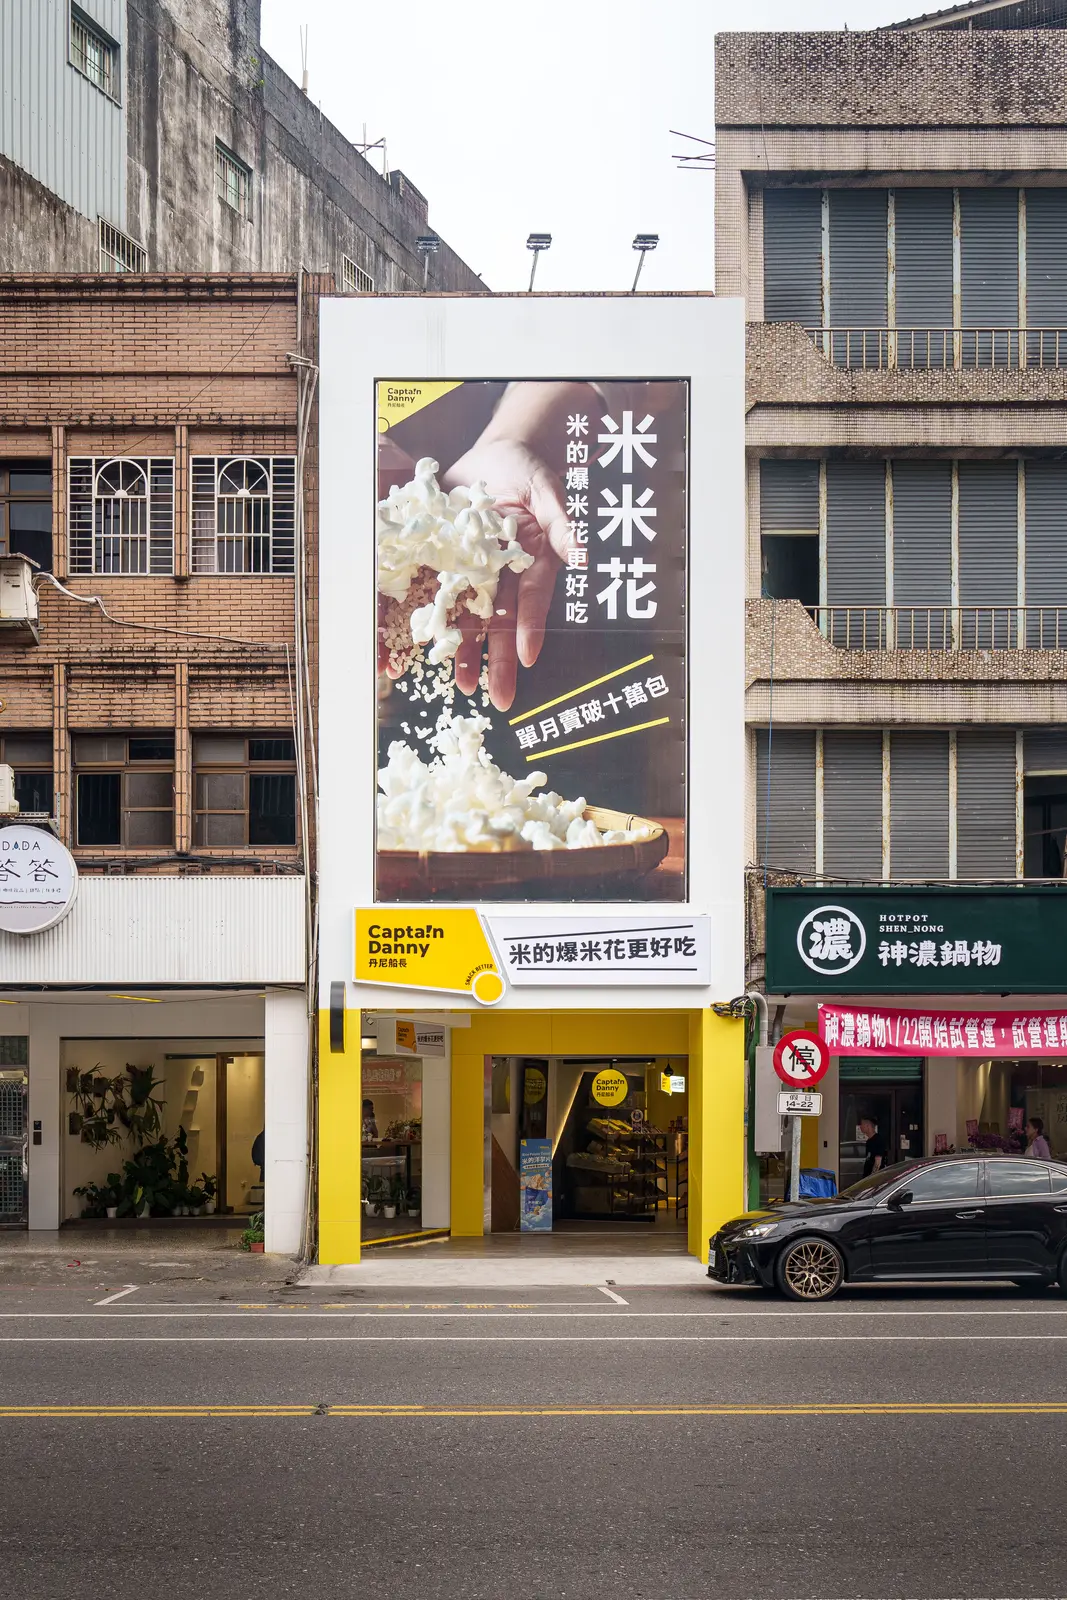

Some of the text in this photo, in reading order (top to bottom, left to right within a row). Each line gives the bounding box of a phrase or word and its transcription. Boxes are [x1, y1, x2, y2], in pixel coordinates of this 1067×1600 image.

[388, 395, 416, 403] Danny
[565, 413, 589, 624] 米的爆米花更好吃
[596, 410, 658, 620] 米米花
[515, 674, 670, 750] 單月賣破十萬包
[2, 841, 41, 851] DADA
[879, 914, 929, 922] HOTPOT
[368, 941, 430, 958] Danny
[509, 935, 697, 965] 米的爆米花更好吃
[809, 917, 853, 960] 濃
[368, 958, 408, 968] 丹尼船長
[877, 940, 1003, 967] 神濃鍋物
[465, 964, 493, 985] SNACK BETTER
[788, 1045, 815, 1072] 停
